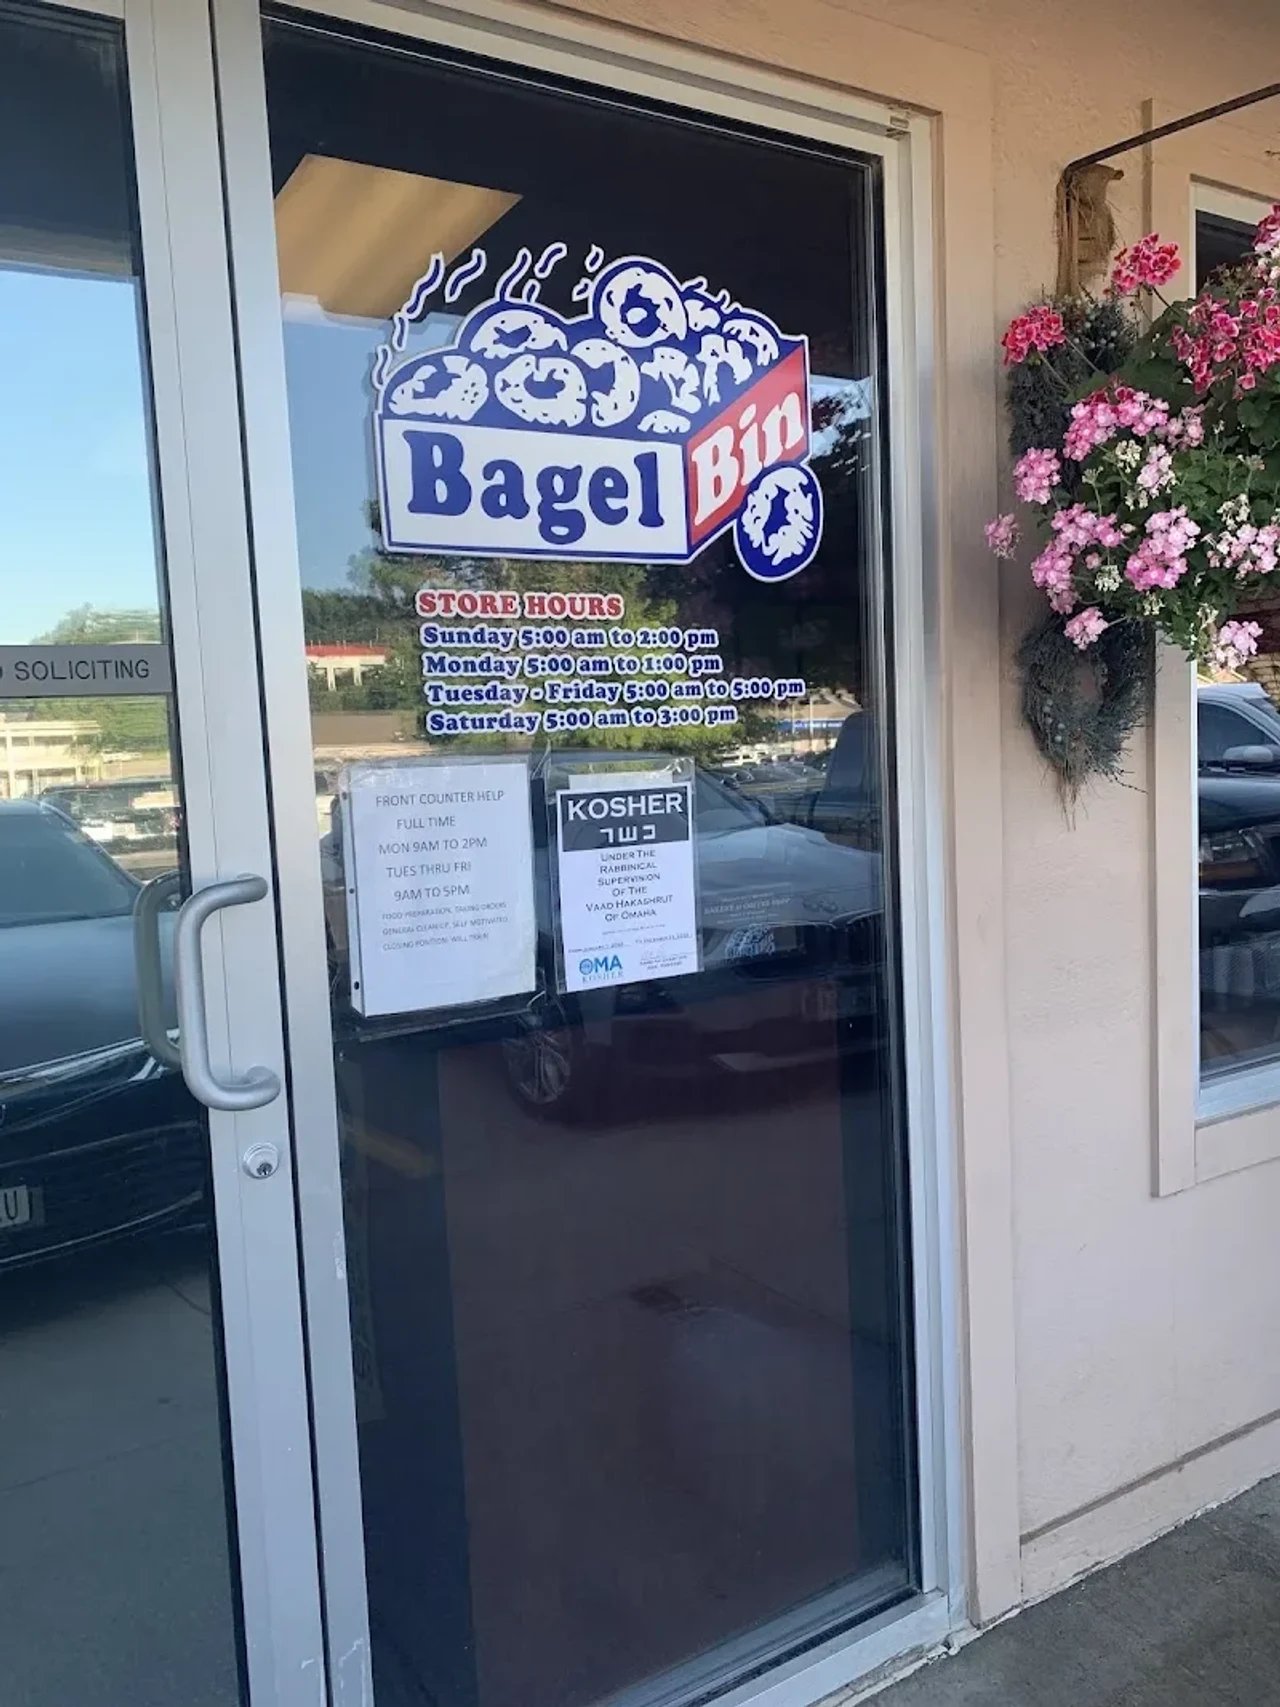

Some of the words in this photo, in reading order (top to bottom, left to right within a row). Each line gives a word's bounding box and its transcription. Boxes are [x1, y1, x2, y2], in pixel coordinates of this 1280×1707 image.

[691, 392, 804, 526] Bin
[402, 430, 665, 545] Bagel
[418, 592, 518, 616] STORE
[526, 594, 623, 617] HOURS
[423, 626, 514, 649] Sunday
[521, 631, 568, 647] 5:00
[573, 632, 605, 646] am
[611, 629, 632, 646] to
[638, 631, 681, 646] 2:00
[686, 632, 718, 650] pm
[14, 659, 150, 681] SOLICITING
[425, 655, 519, 677] Monday
[526, 657, 572, 673] 5:00
[578, 658, 610, 673] am
[616, 656, 637, 673] to
[642, 657, 685, 672] 1:00
[691, 658, 721, 676] pm
[428, 683, 528, 705] Tuesday
[547, 682, 620, 703] Friday
[625, 682, 667, 699] 5:00
[673, 683, 701, 698] am
[707, 681, 728, 697] to
[732, 681, 772, 697] 5:00
[775, 680, 804, 698] pm
[429, 711, 539, 734] Saturday
[544, 711, 591, 728] 5:00
[596, 711, 628, 726] am
[634, 709, 655, 725] to
[660, 708, 701, 725] 3:00
[706, 707, 737, 725] pm
[375, 793, 415, 807] FRONT
[419, 791, 475, 805] COUNTER
[476, 790, 505, 802] HELP
[568, 792, 684, 821] KOSHER
[397, 818, 425, 830] FULL
[428, 816, 456, 828] TIME
[600, 824, 656, 843] כשר
[378, 842, 410, 855] MON
[412, 840, 440, 853] 9AM
[443, 839, 459, 850] TO
[462, 837, 488, 849] 2PM
[601, 851, 635, 863] UNDER
[637, 850, 656, 860] THE
[386, 866, 417, 878] TUES
[420, 864, 450, 875] THRU
[454, 861, 472, 873] FRI
[393, 889, 423, 902] 9AM
[424, 887, 441, 898] TO
[442, 884, 471, 897] 5PM
[628, 885, 648, 895] THE
